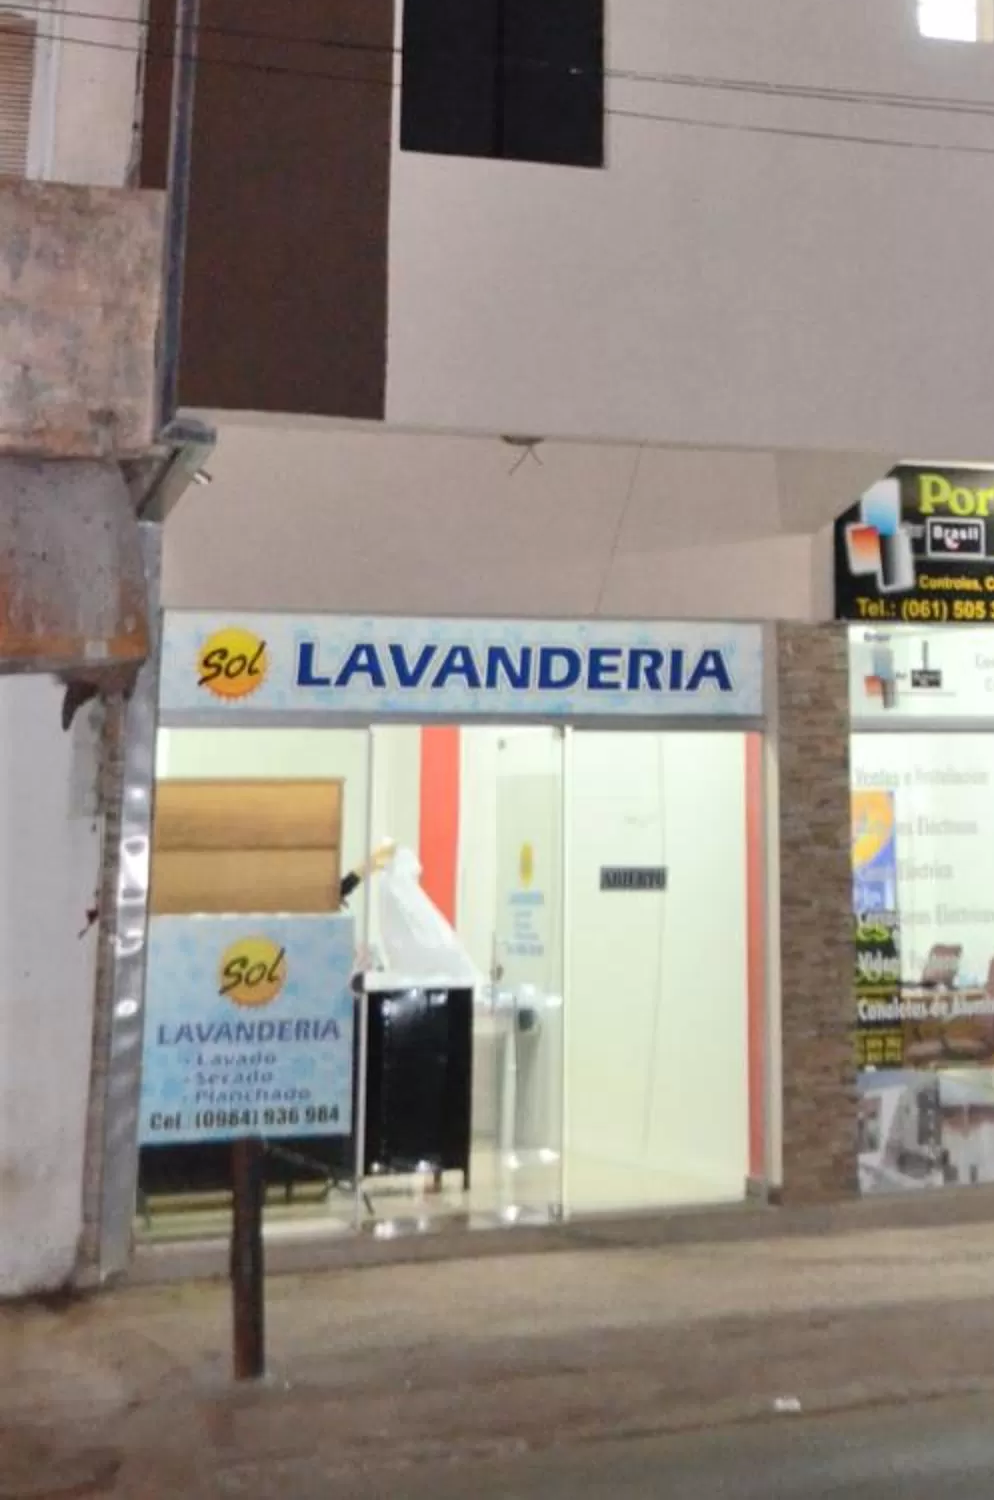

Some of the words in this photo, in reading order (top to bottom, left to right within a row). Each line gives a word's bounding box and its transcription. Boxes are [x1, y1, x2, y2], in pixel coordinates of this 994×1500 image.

[933, 525, 979, 541] Brasil
[902, 599, 948, 621] (061)
[953, 600, 986, 619] 505
[197, 639, 266, 686] Sol
[296, 642, 733, 692] LAVANDERIA
[218, 947, 286, 996] Sol
[157, 1017, 341, 1045] LAVANDERIA
[196, 1051, 277, 1066] Lavado
[195, 1069, 273, 1085] Secado
[195, 1087, 312, 1105] Planchado
